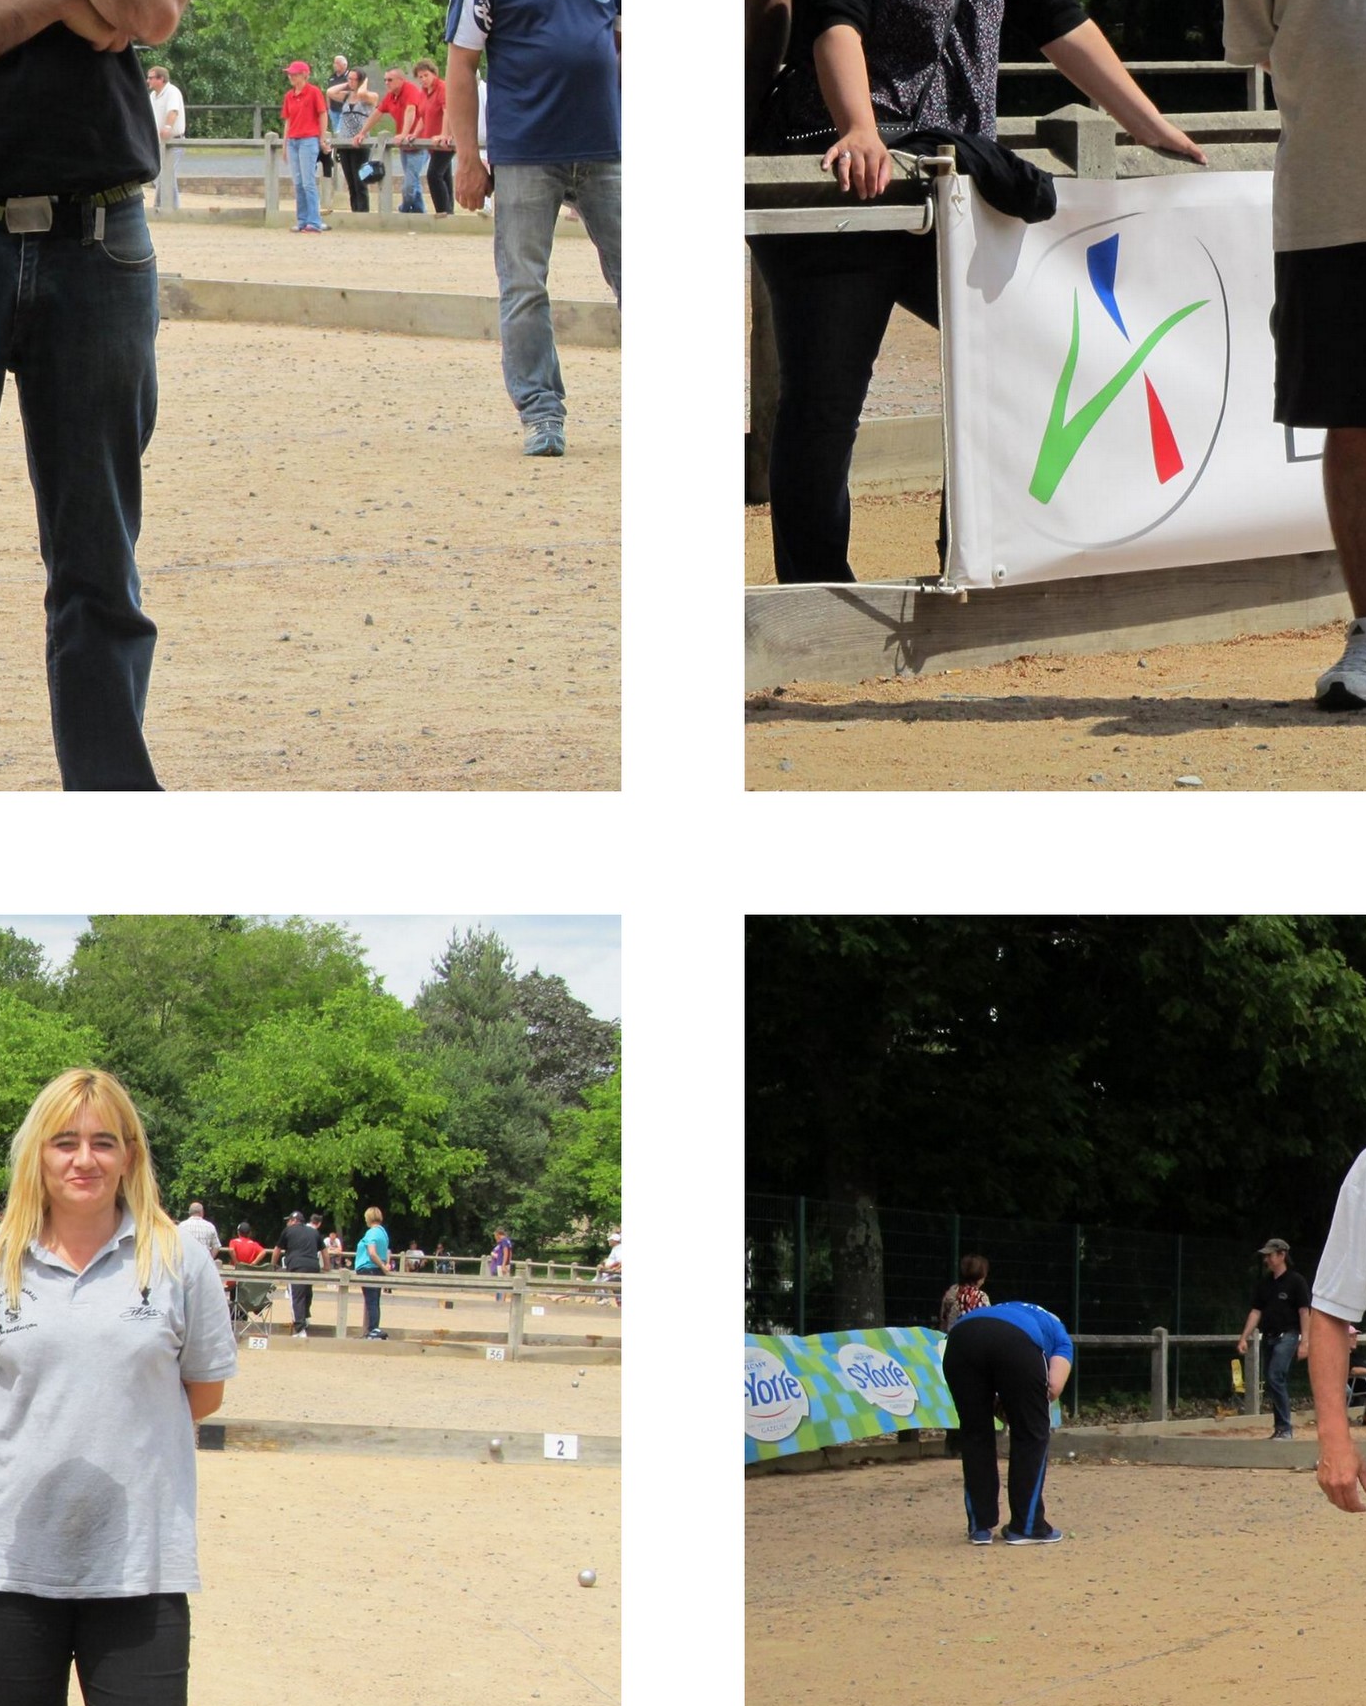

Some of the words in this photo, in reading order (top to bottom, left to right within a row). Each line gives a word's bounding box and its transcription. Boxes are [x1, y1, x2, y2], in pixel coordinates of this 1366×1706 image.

[253, 1338, 265, 1349] 35
[490, 1349, 502, 1360] 36
[556, 1439, 565, 1456] 2
